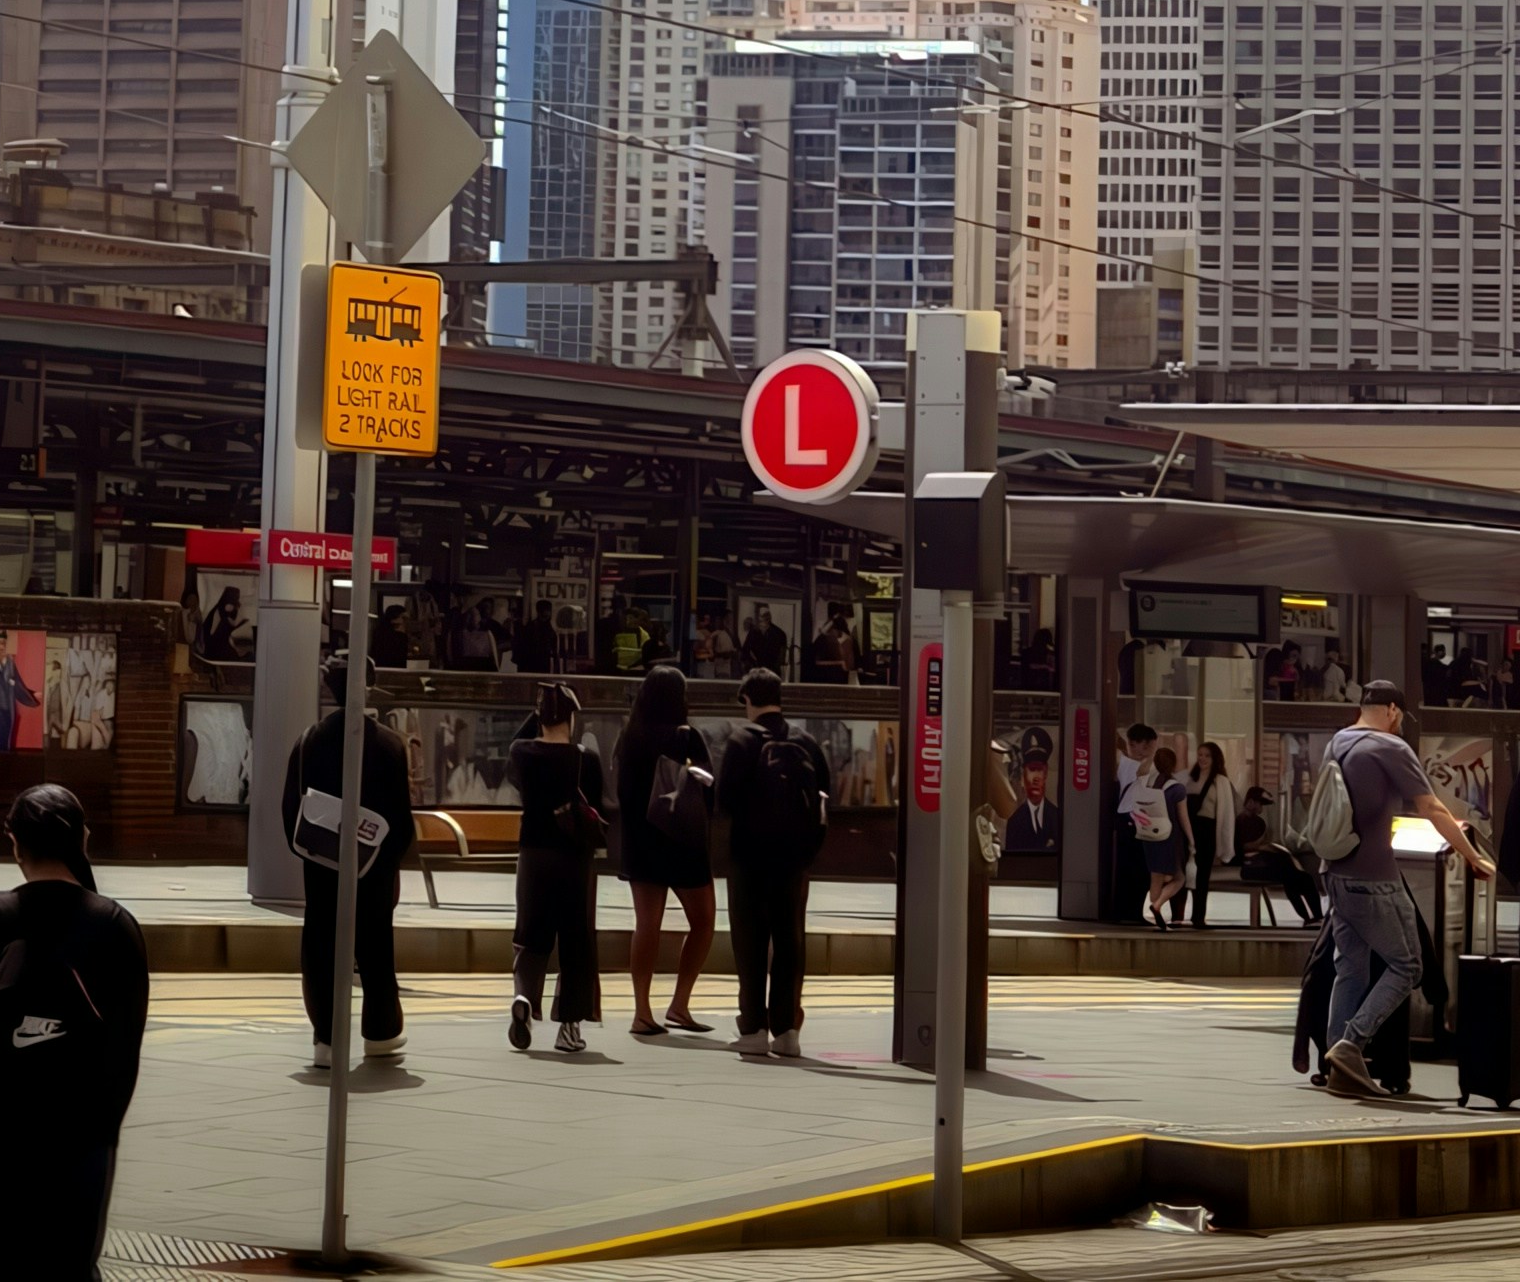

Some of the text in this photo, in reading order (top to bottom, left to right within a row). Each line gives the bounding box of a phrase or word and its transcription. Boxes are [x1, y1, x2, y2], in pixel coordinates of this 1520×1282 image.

[341, 360, 423, 386] LOOK FOR
[337, 385, 382, 410] LIGHT
[339, 414, 421, 441] 2 TRACKS
[784, 384, 828, 466] L
